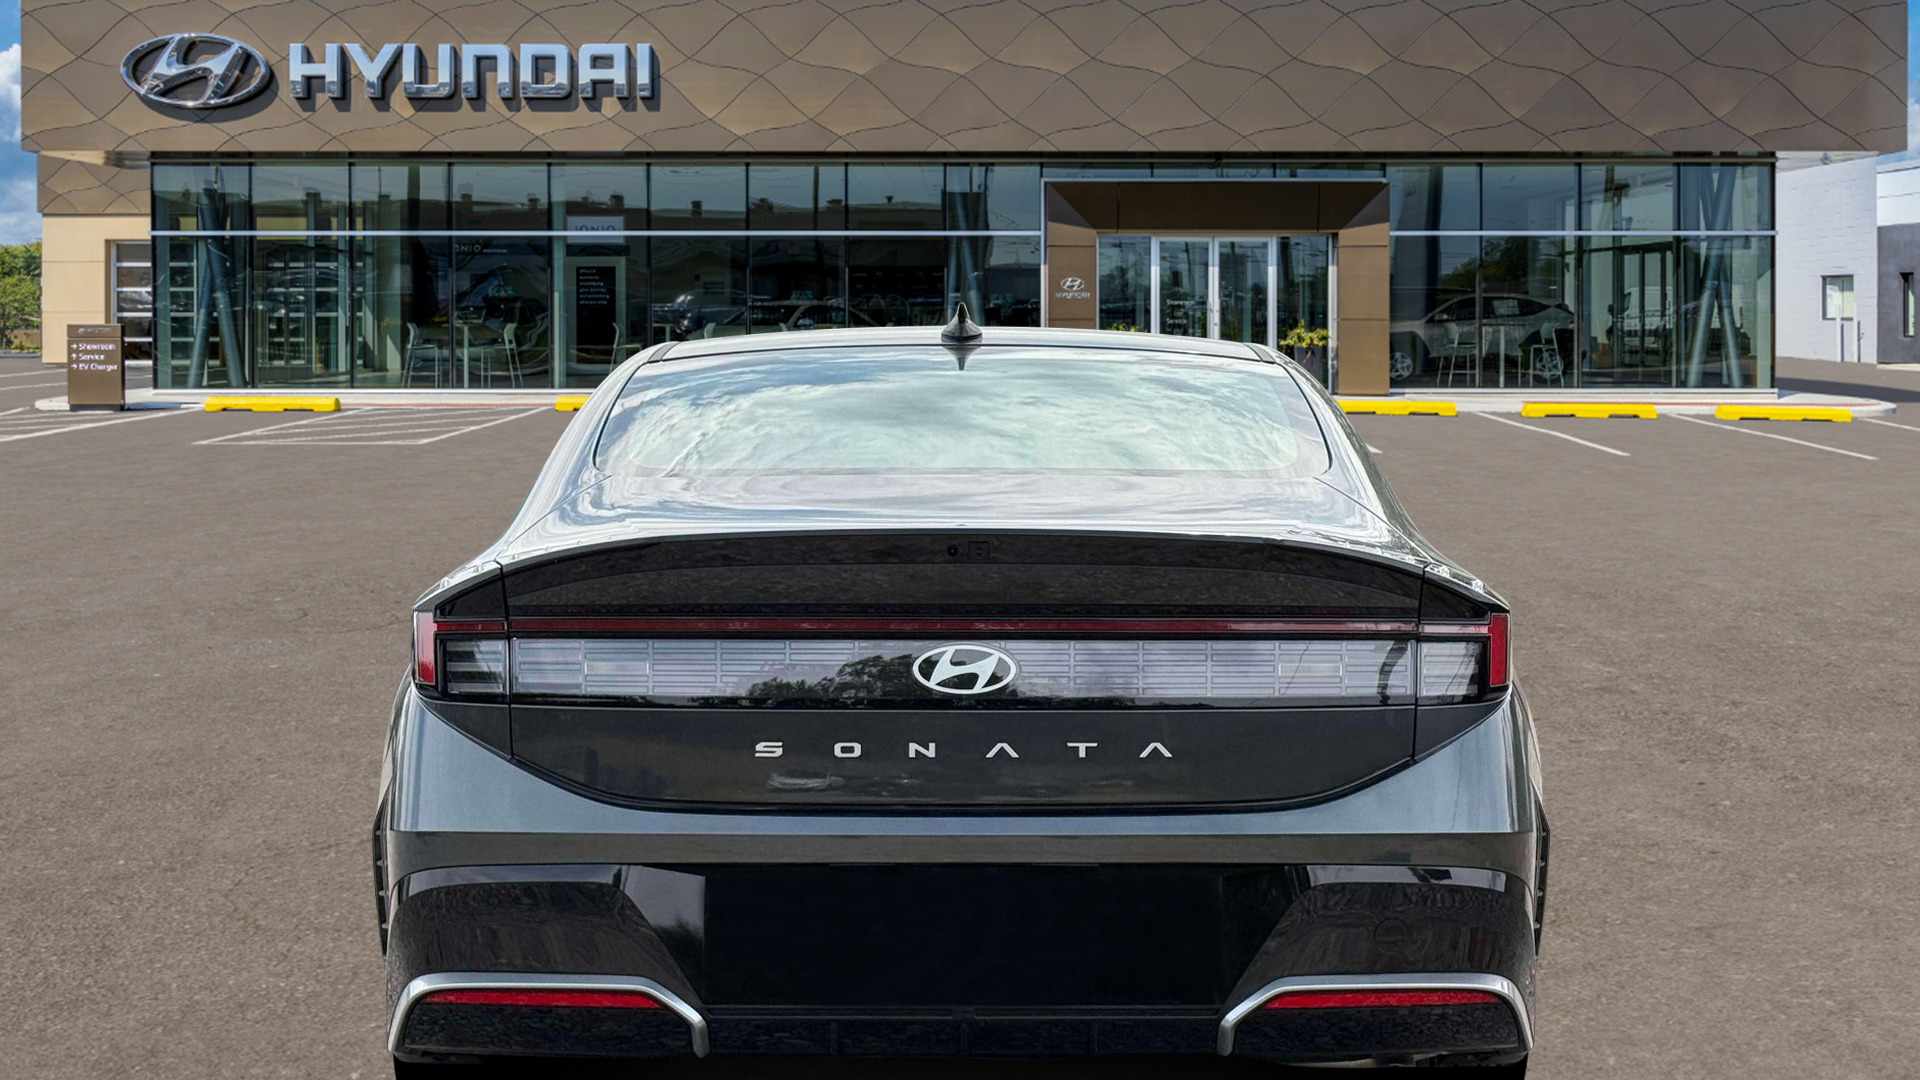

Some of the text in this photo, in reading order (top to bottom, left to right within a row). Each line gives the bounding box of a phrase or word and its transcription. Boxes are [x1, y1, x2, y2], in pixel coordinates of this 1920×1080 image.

[289, 42, 656, 99] HYUNDAI
[78, 352, 105, 360] Service
[90, 363, 118, 372] Charger
[754, 741, 1173, 759] SONATA
